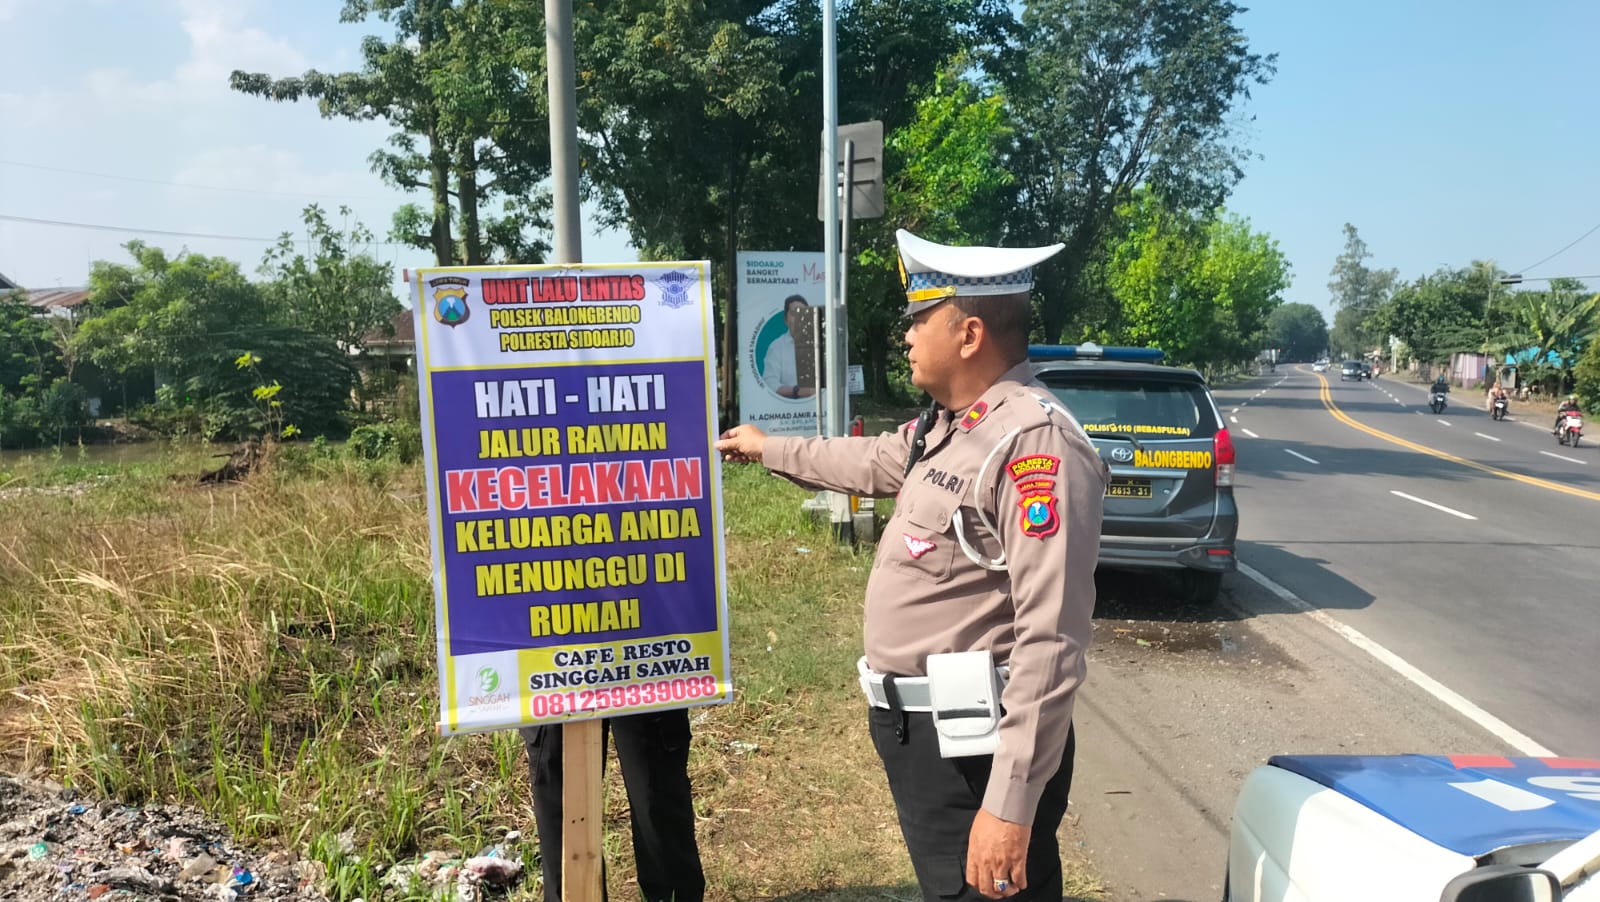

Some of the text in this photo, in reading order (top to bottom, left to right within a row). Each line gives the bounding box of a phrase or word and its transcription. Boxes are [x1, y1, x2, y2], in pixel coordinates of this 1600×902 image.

[481, 275, 645, 304] UNIT LALU LINTAS
[490, 308, 543, 328] POLSEK
[544, 304, 641, 326] BALONGBENDO
[500, 329, 635, 352] POLRESTA SIDOARJO
[474, 374, 666, 418] HATI - HATI
[749, 413, 757, 421] H.
[758, 412, 792, 420] ACHMAD
[793, 411, 810, 419] AMIR
[1083, 424, 1109, 432] POLISI
[478, 422, 667, 459] JALUR RAWAN
[1011, 458, 1053, 471] POLRESTA
[1134, 449, 1212, 469] BALONGBENDO
[445, 457, 703, 514] KECELAKAAN
[923, 468, 964, 495] POLRI
[455, 508, 701, 553] KELUARGA ANDA
[475, 551, 686, 597] MENUNGGU DI
[529, 598, 641, 637] RUMAH
[554, 639, 692, 667] CAFE RESTO
[530, 656, 711, 690] SINGGAH SAWAH
[468, 693, 510, 706] SINGGAH
[532, 675, 716, 717] 081259339088
